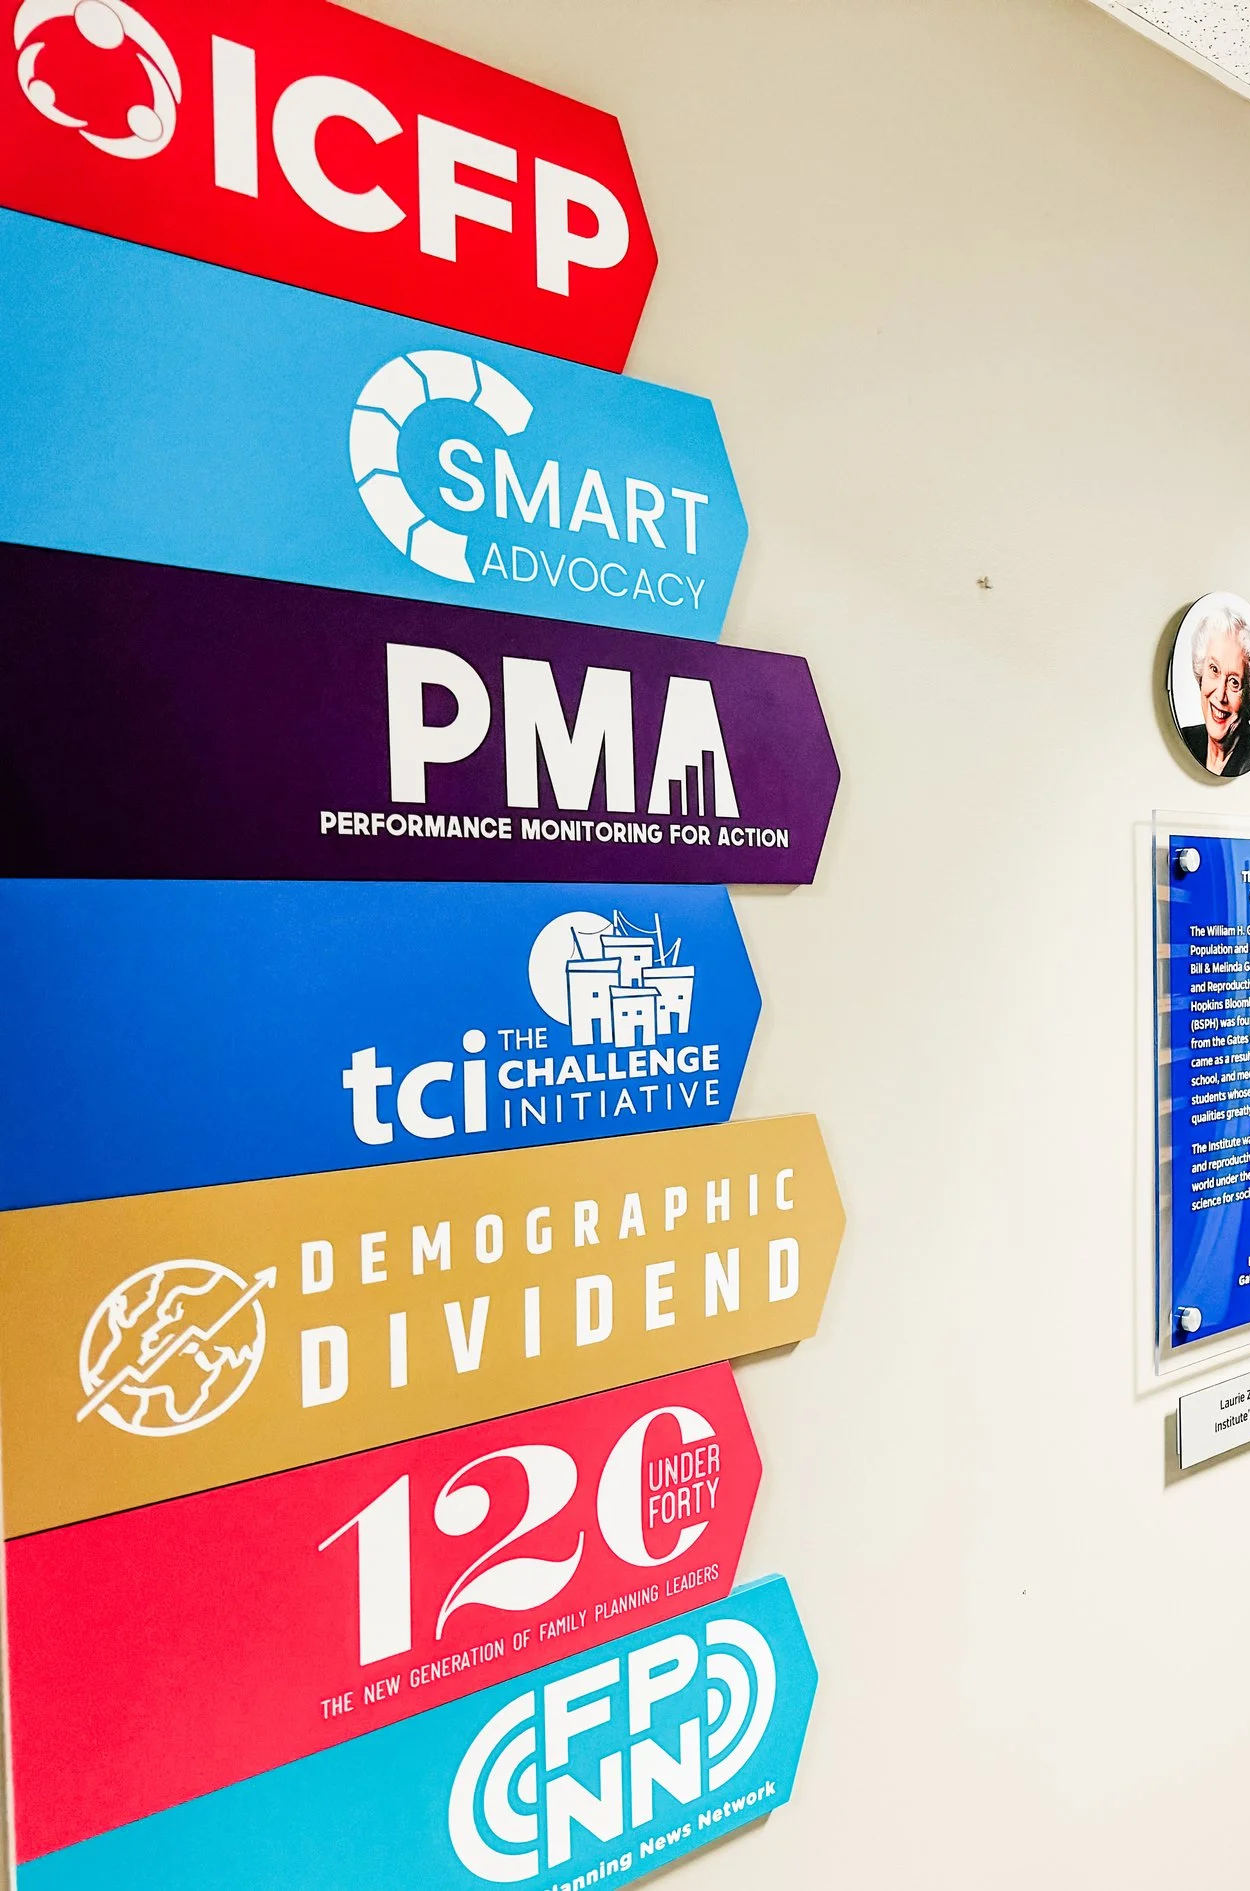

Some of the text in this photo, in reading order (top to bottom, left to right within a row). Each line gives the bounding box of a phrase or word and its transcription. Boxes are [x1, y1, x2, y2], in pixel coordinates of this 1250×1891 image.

[212, 34, 630, 297] ICFP
[438, 438, 709, 555] SMART
[481, 542, 706, 611] ADVOCACY
[387, 642, 740, 818] PMA
[320, 811, 789, 848] PERFORMANCE MONITORING FOR ACTION
[1190, 944, 1233, 956] Population
[1234, 943, 1249, 954] and
[1191, 926, 1206, 937] The
[1207, 925, 1236, 936] William
[1237, 926, 1246, 936] H.
[1190, 984, 1206, 993] and
[1191, 963, 1203, 974] Bill
[1204, 963, 1211, 974] &
[1212, 961, 1243, 973] Melinda
[1191, 999, 1224, 1012] Hopkins
[498, 1027, 548, 1051] THE
[1191, 1039, 1211, 1049] from
[1212, 1036, 1226, 1047] the
[1227, 1034, 1249, 1045] Gates
[342, 1029, 487, 1146] tci
[498, 1045, 720, 1090] CHALLENGE
[505, 1079, 720, 1129] INITIATIVE
[301, 1167, 794, 1296] DEMOGRAPHIC
[301, 1235, 800, 1408] DIVIDEND
[1220, 1393, 1245, 1411] Laurie
[649, 1444, 720, 1491] UNDER
[649, 1477, 720, 1528] FORTY
[321, 1563, 719, 1720] THE NEW GENERATION OF FAMILY PLANNING LEADERS
[545, 1780, 776, 1891] anning News Network
